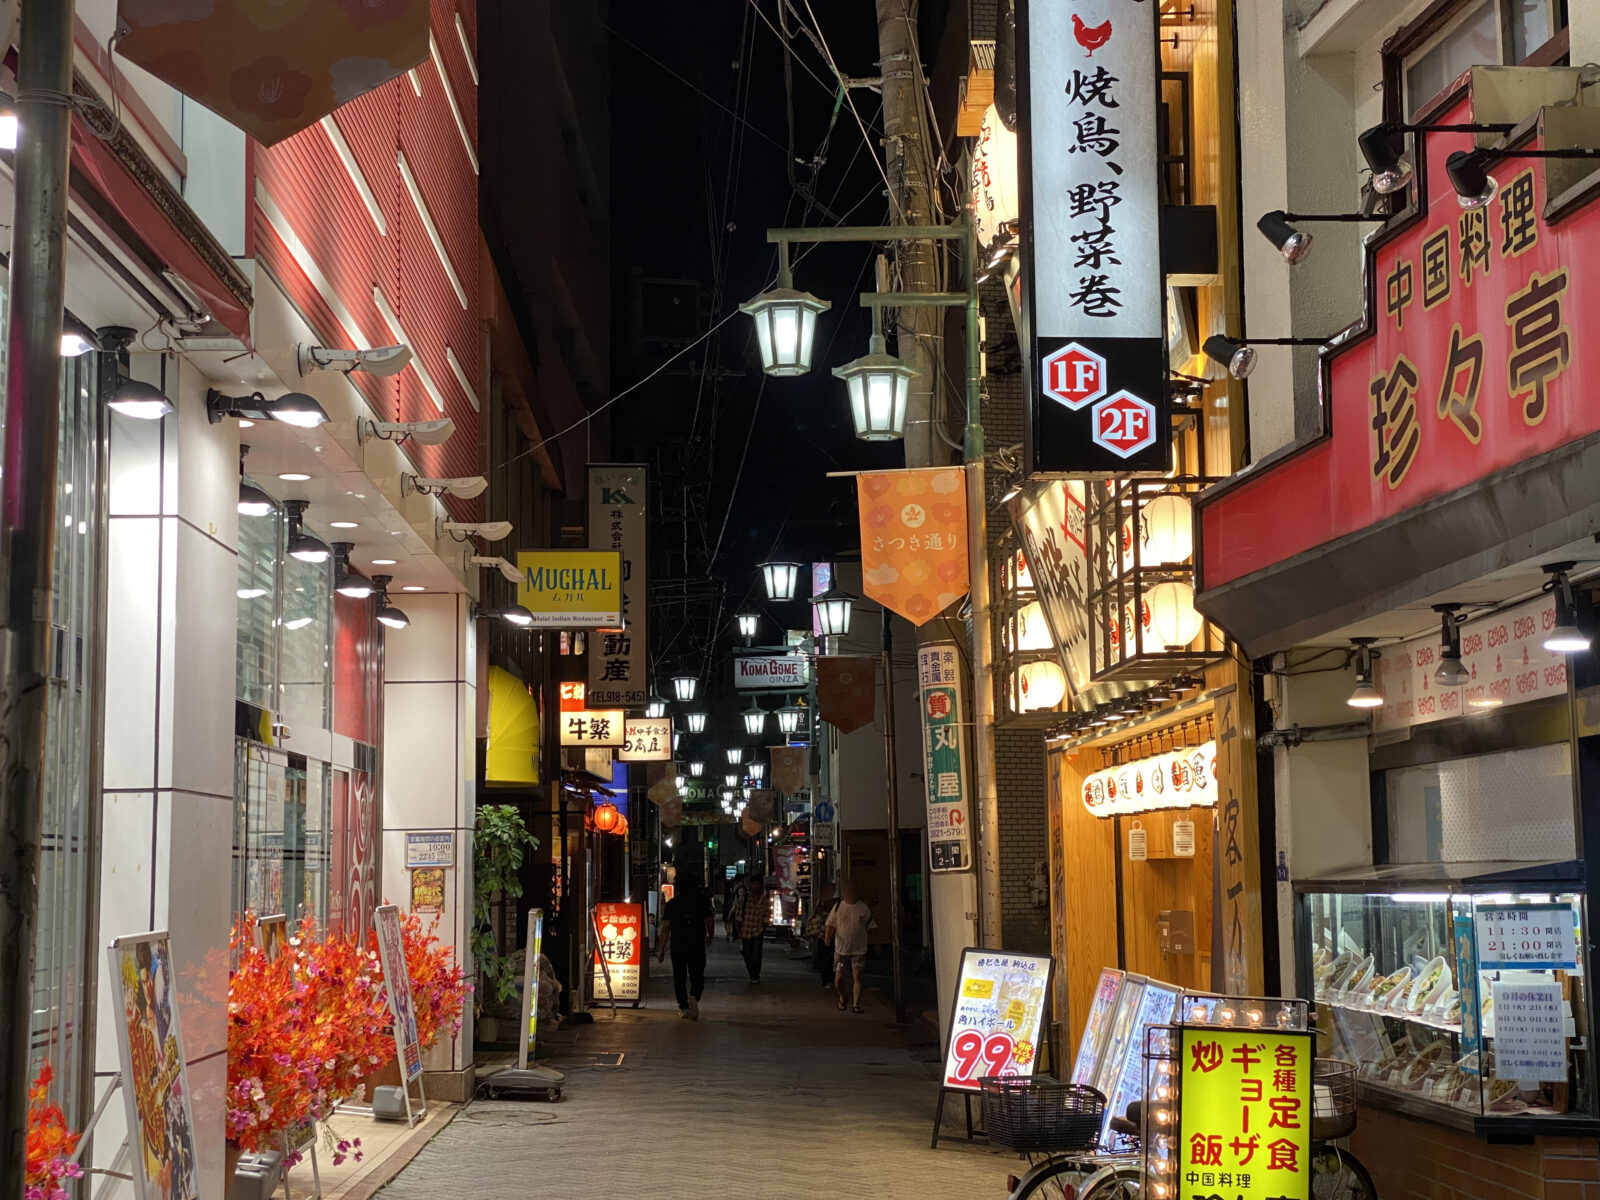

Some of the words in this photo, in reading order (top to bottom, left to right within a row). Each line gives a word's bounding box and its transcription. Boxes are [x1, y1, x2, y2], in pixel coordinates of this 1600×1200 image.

[1065, 66, 1123, 318] 焼鳥、野菜巻
[1387, 168, 1537, 330] 中国料理
[1054, 361, 1098, 394] 1F
[1370, 267, 1570, 488] 珍々亭
[1101, 407, 1147, 440] 2F
[873, 532, 957, 552] さつき通り
[526, 566, 612, 592] MUGHAL
[943, 651, 955, 681] 楽器
[769, 675, 799, 683] GINZA
[929, 695, 948, 717] 質
[568, 717, 610, 740] 牛繁
[934, 725, 960, 798] 丸屋
[429, 843, 451, 851] 10:00
[938, 857, 955, 866] 2-1
[1484, 911, 1529, 921] 営業時間
[1488, 926, 1541, 936] 11:30
[1488, 940, 1542, 951] 21:00
[957, 1014, 1015, 1029] 角ハイボール
[1190, 1040, 1224, 1166] 炒飯
[1229, 1042, 1266, 1166] ギョーザ
[1267, 1043, 1301, 1173] 各種定食
[1186, 1170, 1251, 1188] 中国料理
